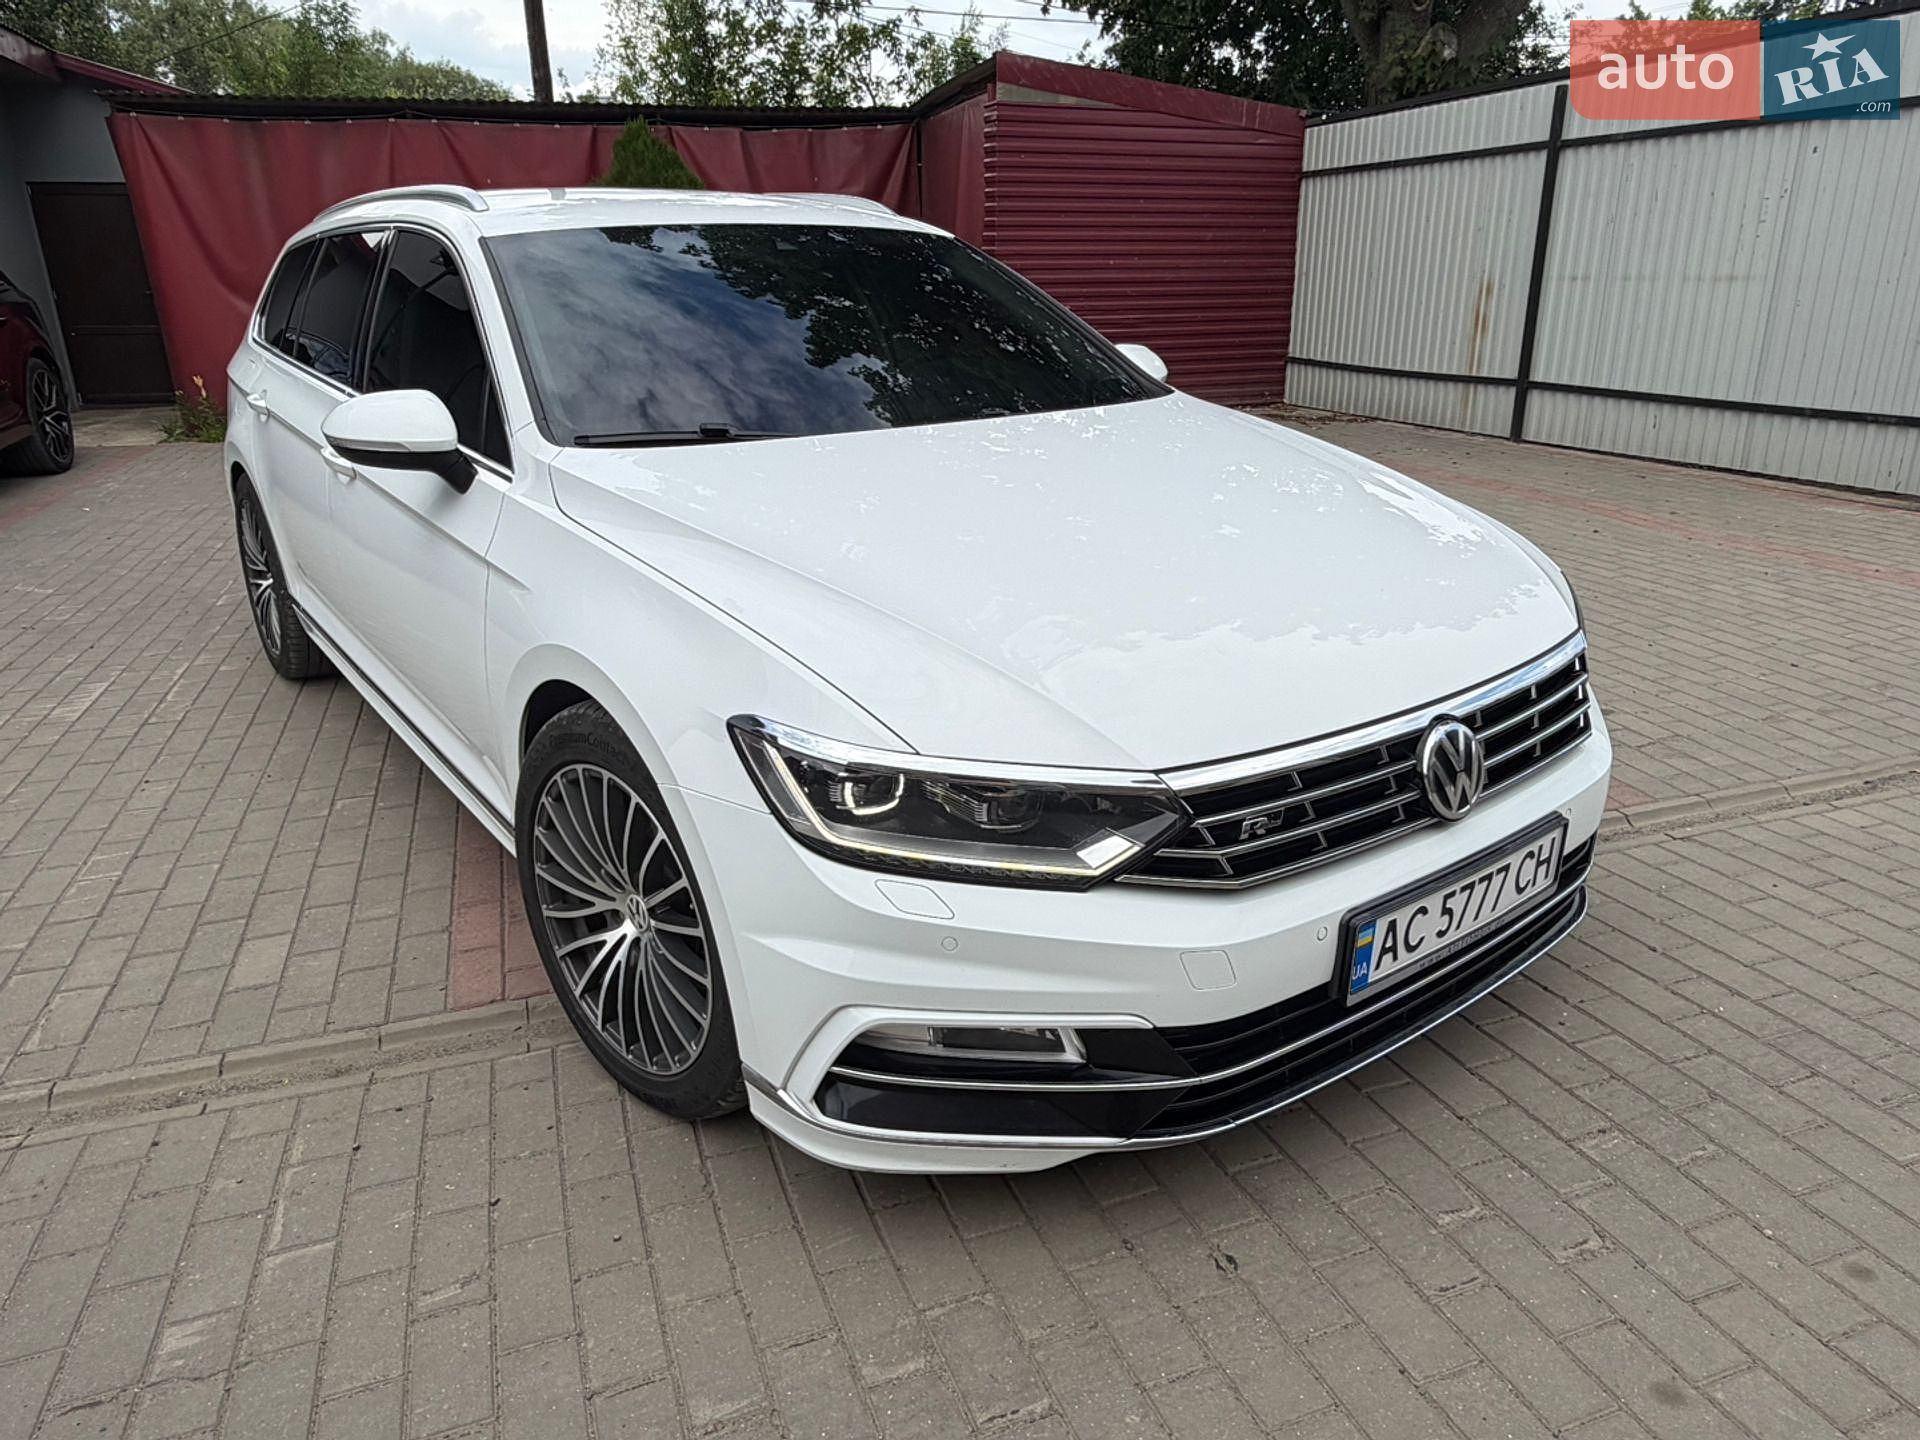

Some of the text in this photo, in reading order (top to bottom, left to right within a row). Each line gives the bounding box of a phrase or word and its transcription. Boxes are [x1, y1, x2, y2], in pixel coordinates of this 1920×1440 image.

[1374, 905, 1429, 972] AC
[1435, 862, 1512, 940] 5777
[1514, 836, 1557, 895] CH
[1351, 962, 1369, 981] UA
